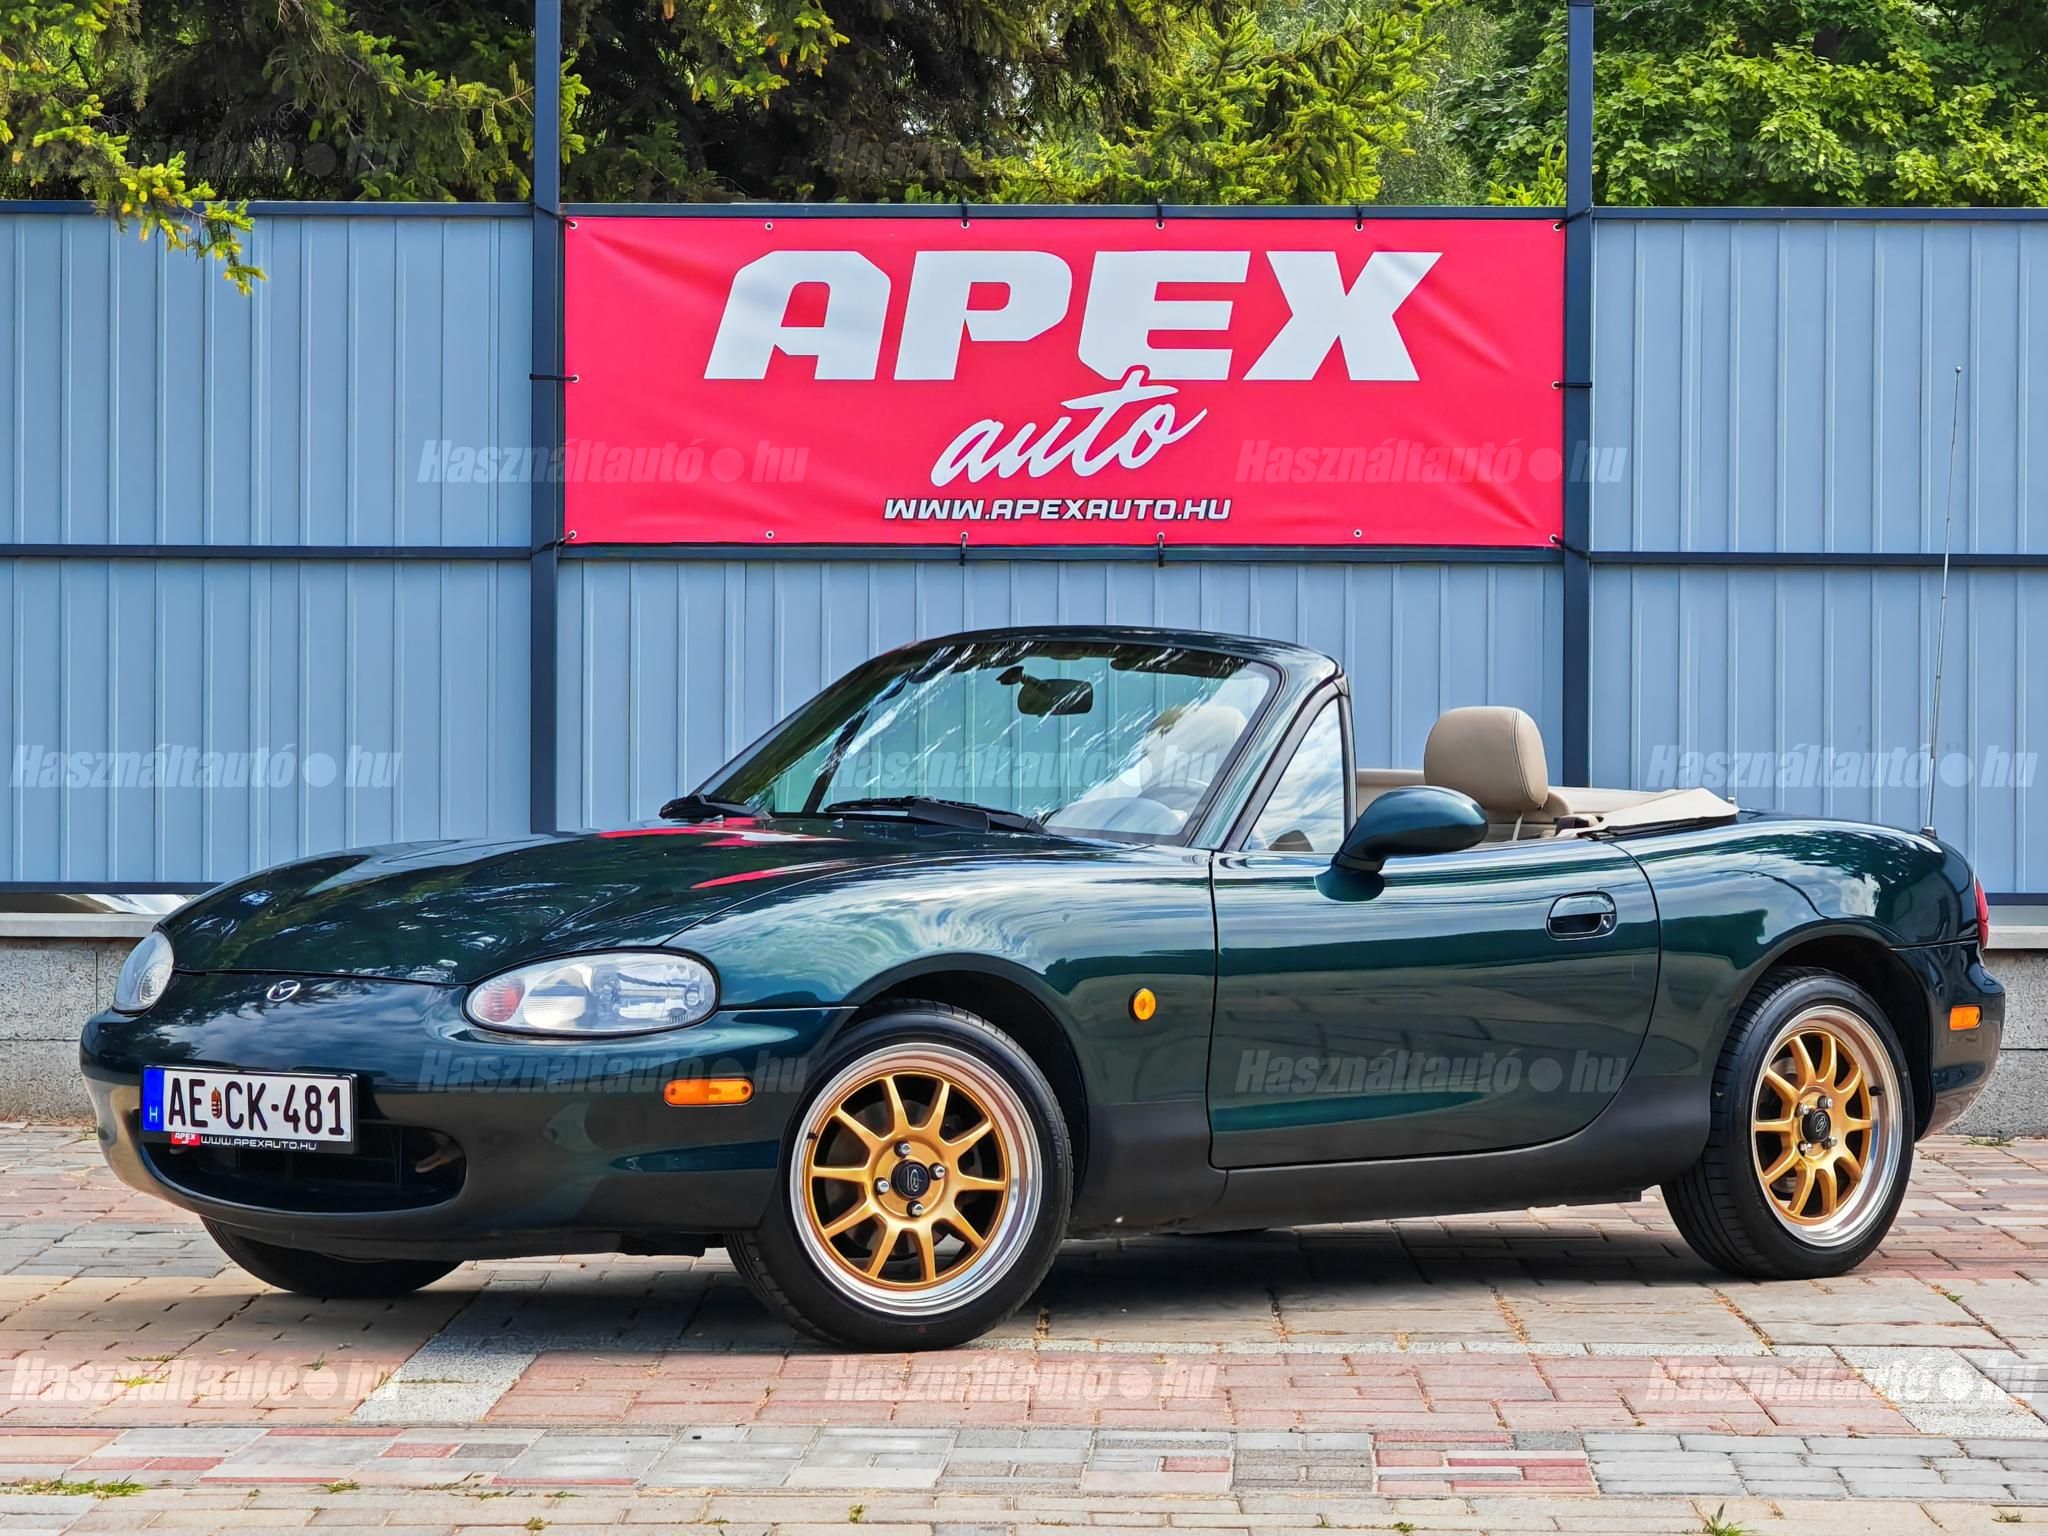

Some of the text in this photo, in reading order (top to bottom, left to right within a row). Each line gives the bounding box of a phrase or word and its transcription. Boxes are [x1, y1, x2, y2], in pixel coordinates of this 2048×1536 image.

[703, 250, 1444, 382] APEX
[930, 367, 1208, 487] auto
[883, 498, 1233, 521] WWW.APEXAUTO.HU
[149, 1107, 159, 1122] H
[168, 1077, 209, 1128] AE
[200, 1136, 317, 1151] WWW.APEXAUTO.HU
